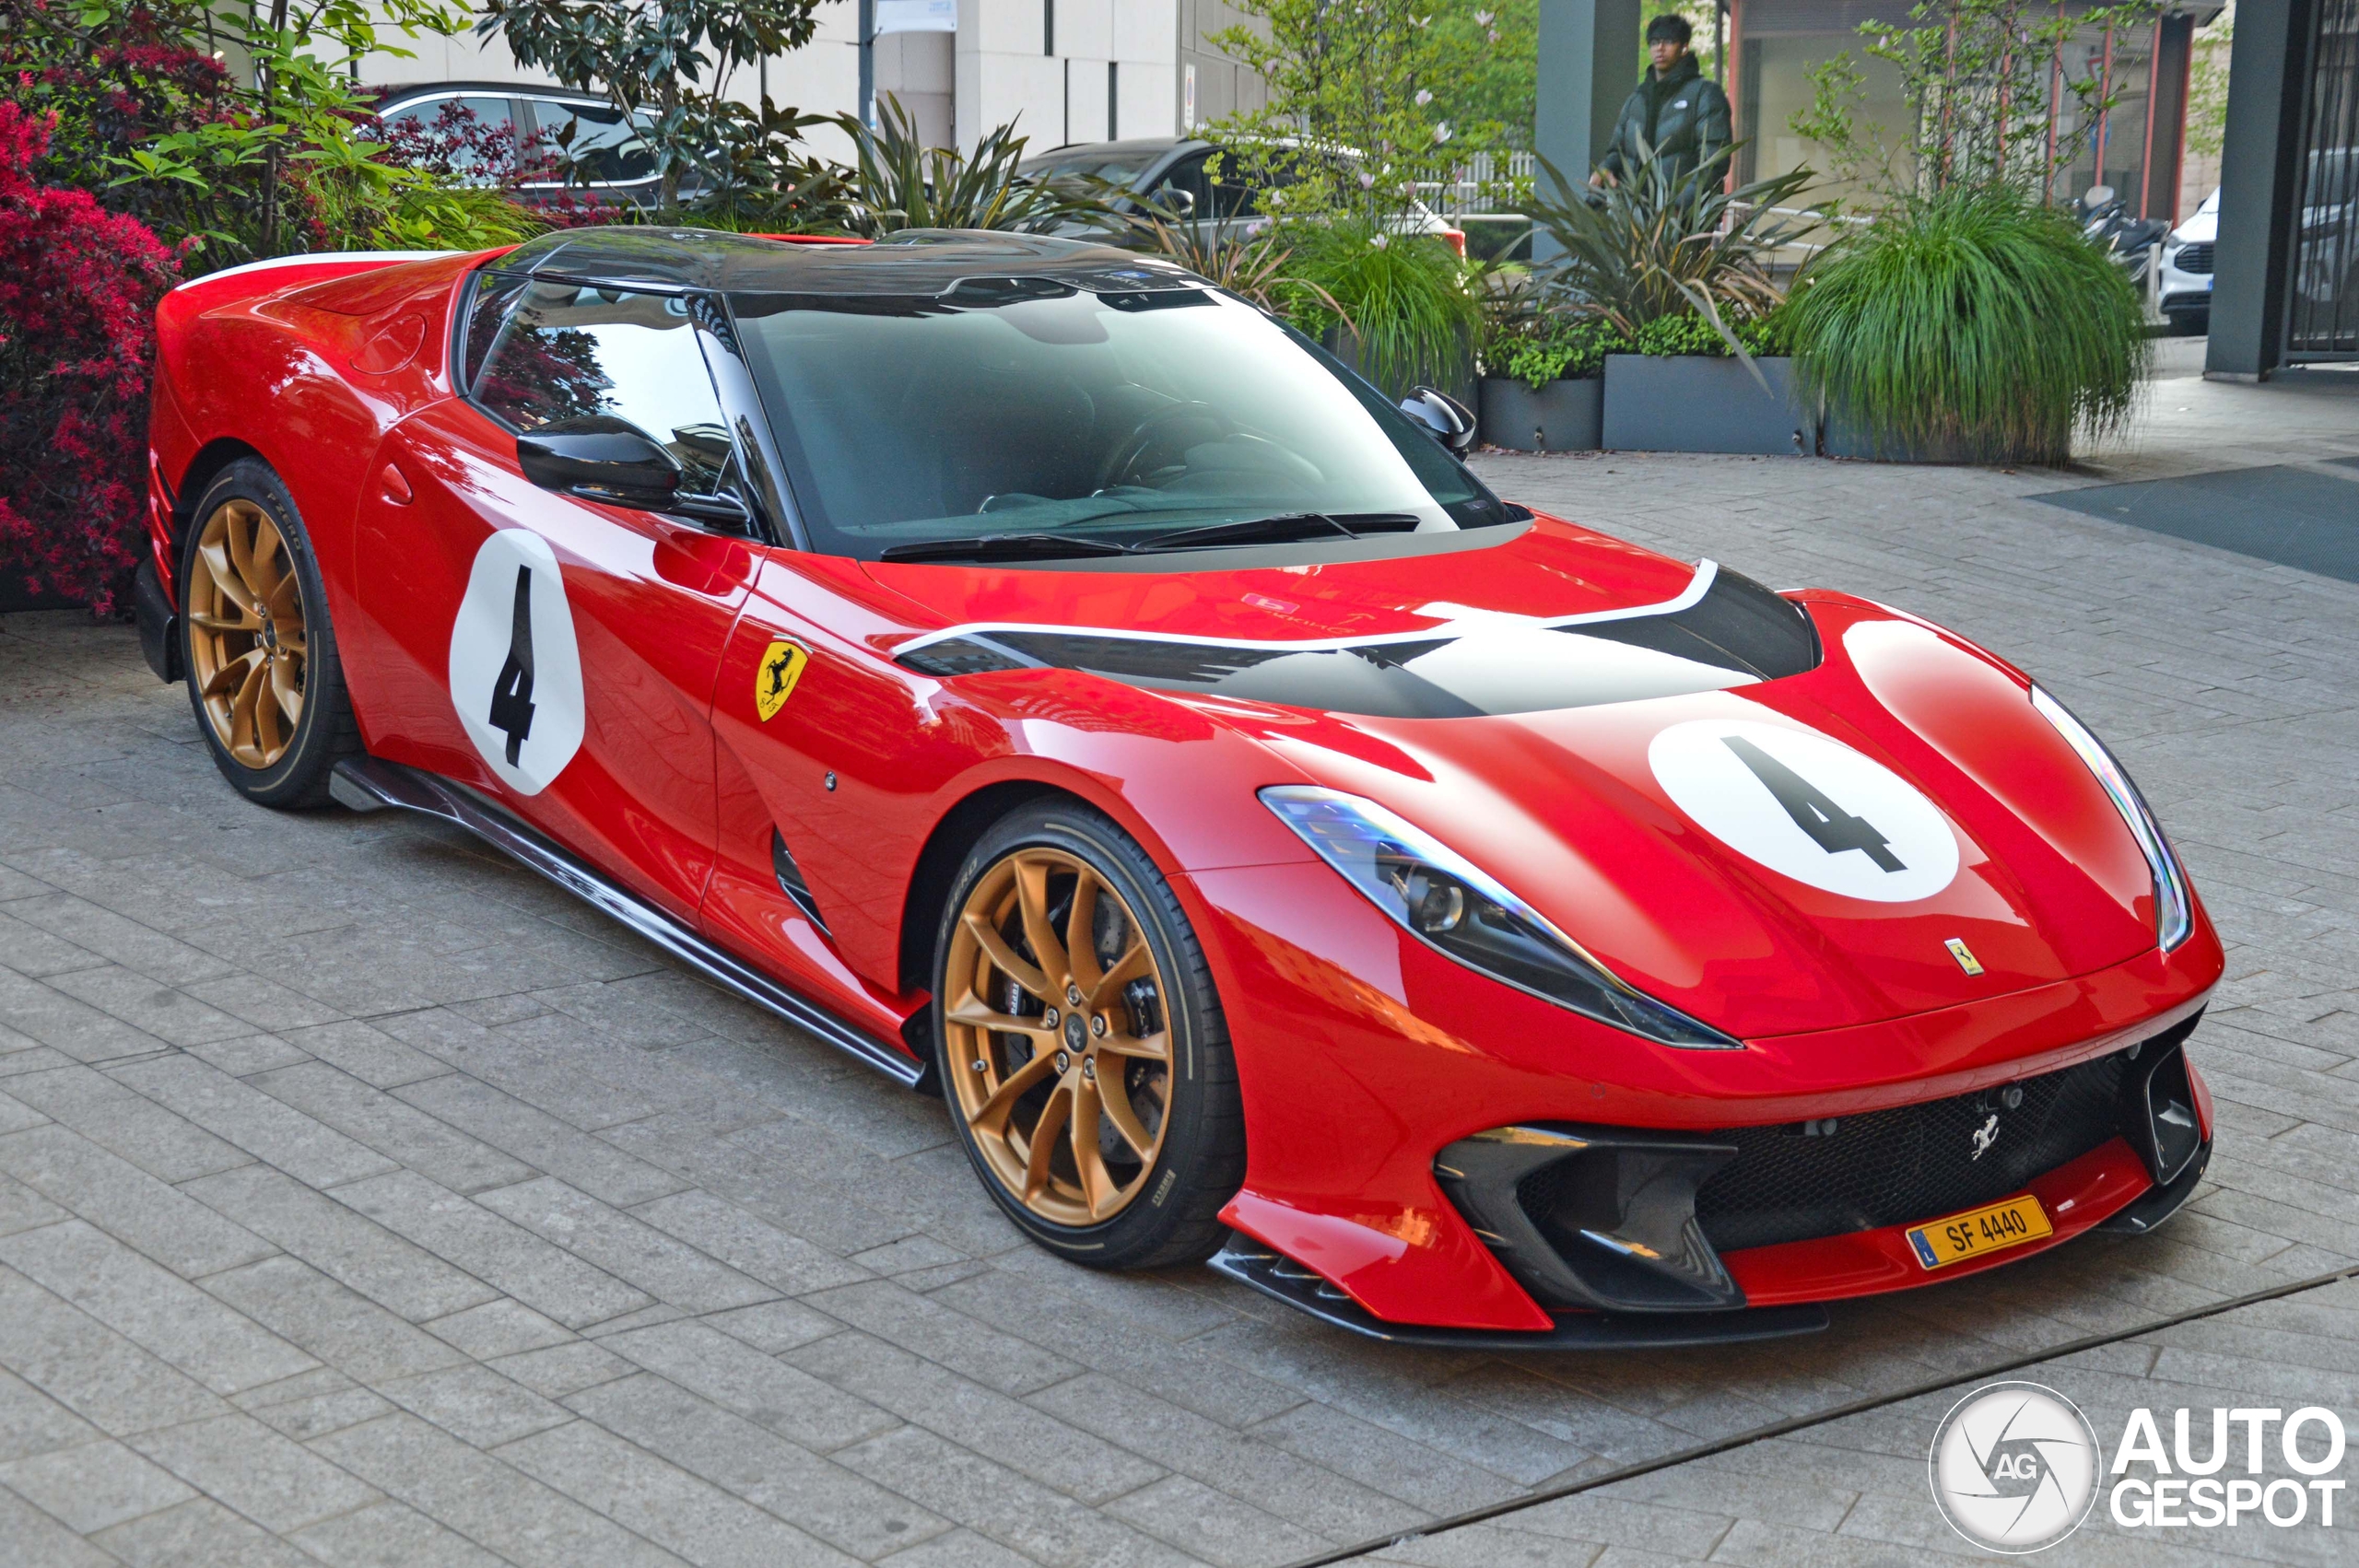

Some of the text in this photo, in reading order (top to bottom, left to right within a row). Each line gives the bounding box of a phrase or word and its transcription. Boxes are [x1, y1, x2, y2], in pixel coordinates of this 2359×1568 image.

[275, 502, 302, 550] ZERO
[489, 564, 535, 769] 4
[1719, 735, 1908, 873] 4
[1151, 1168, 1177, 1208] PIRELLI
[1945, 1208, 2027, 1252] SF 4440
[1924, 1251, 1933, 1262] L
